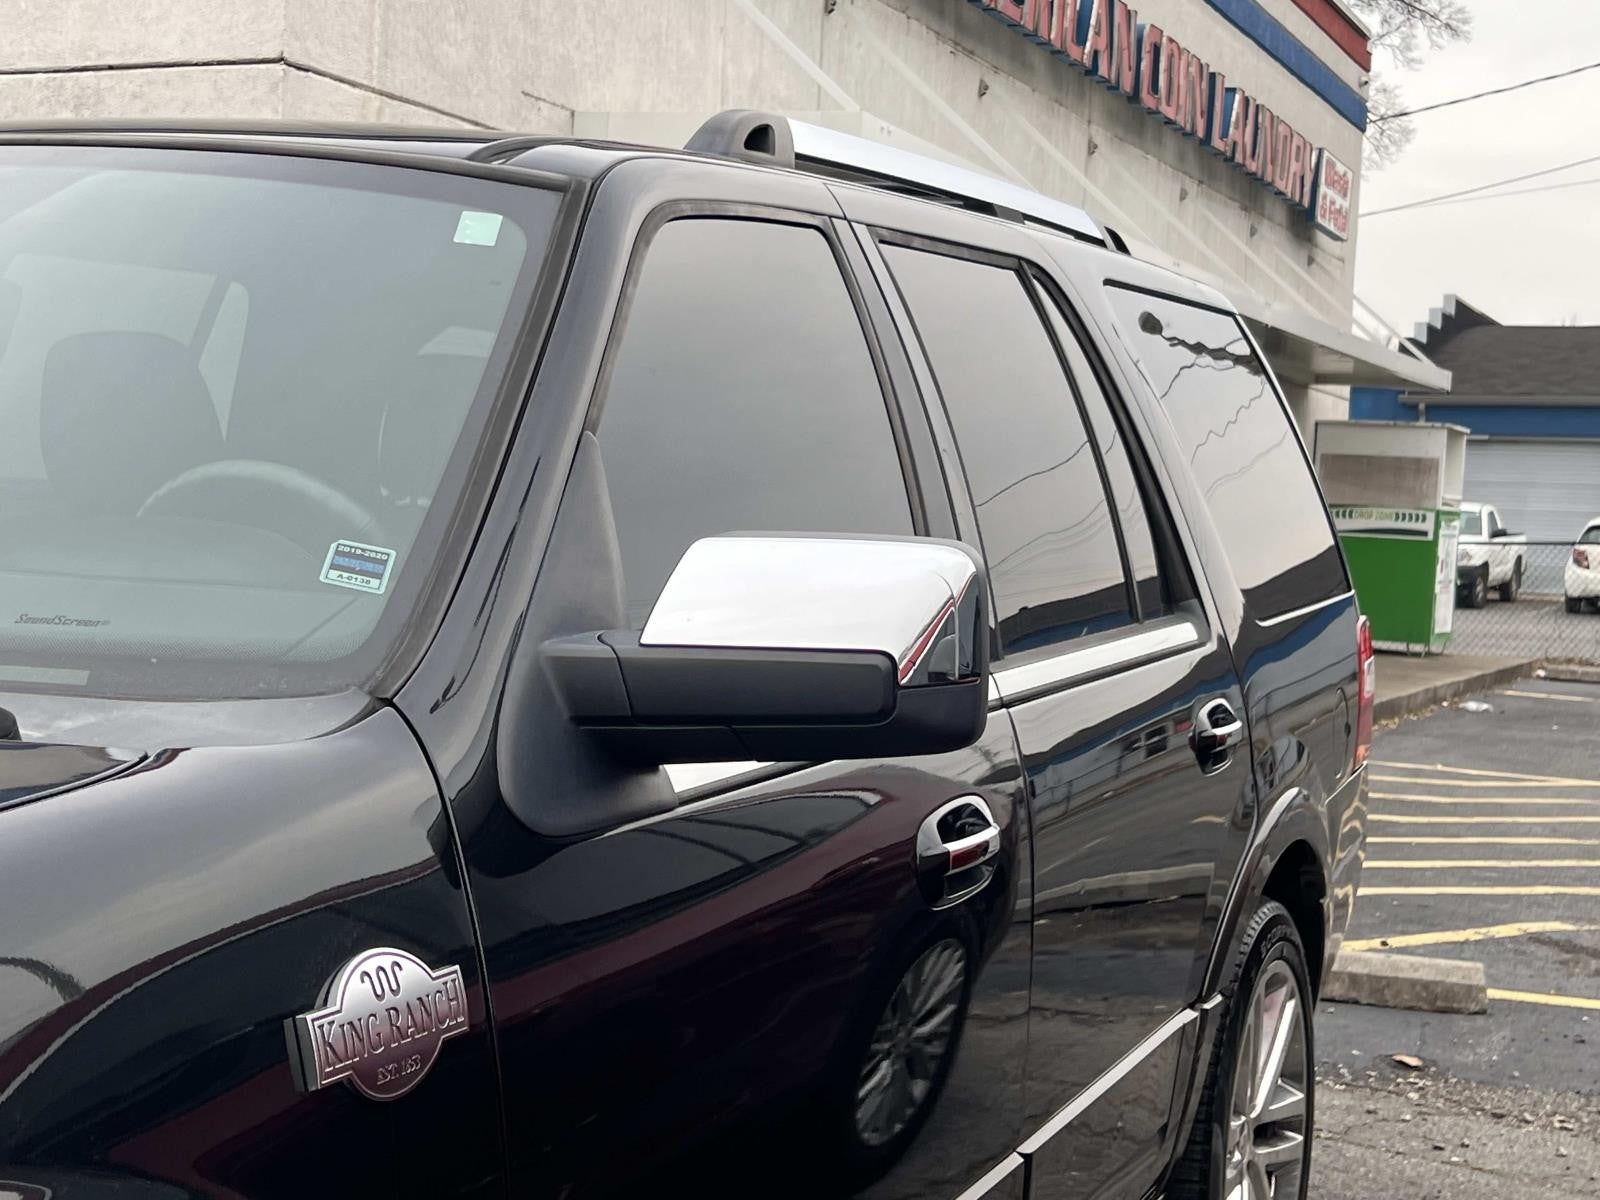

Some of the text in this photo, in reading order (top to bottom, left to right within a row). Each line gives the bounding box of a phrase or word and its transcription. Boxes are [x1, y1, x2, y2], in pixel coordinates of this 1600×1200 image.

[1139, 24, 1209, 139] COIN
[1211, 72, 1315, 208] LAUNDRY
[336, 545, 388, 561] 2019-2020
[317, 978, 465, 1072] KING RANCH
